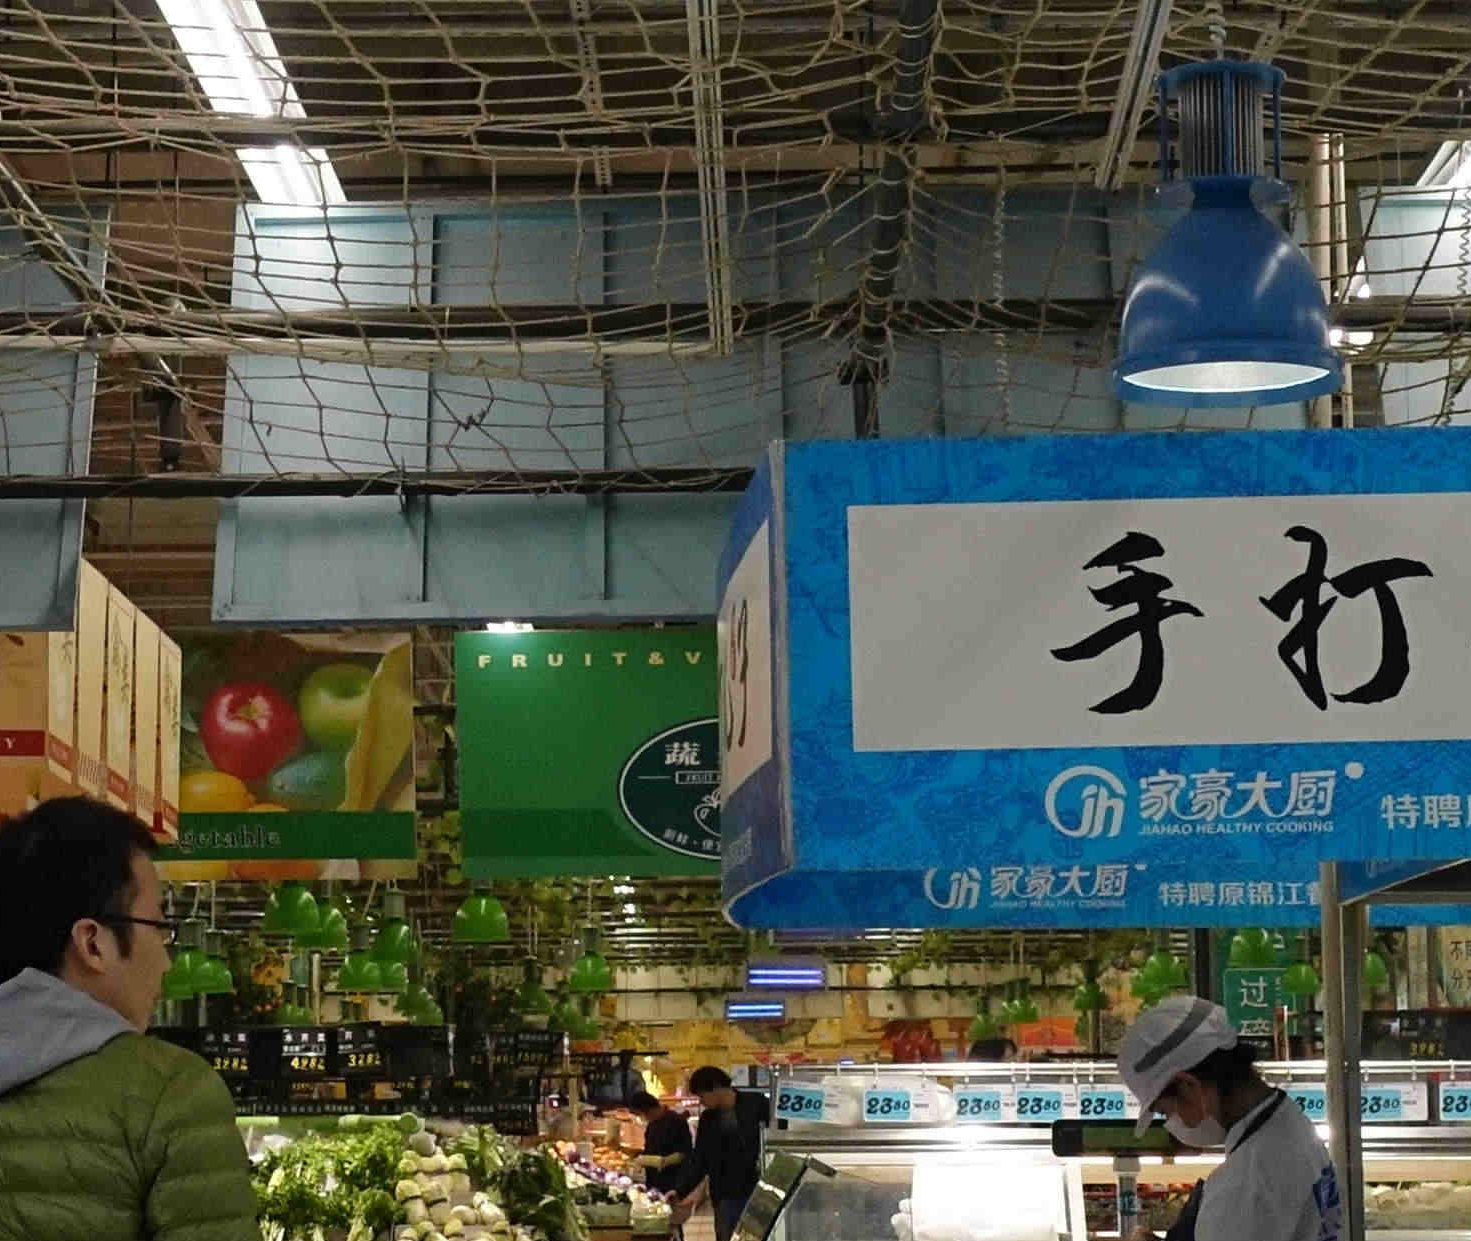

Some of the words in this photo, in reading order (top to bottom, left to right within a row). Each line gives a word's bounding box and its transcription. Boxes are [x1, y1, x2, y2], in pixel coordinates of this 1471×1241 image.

[1139, 769, 1337, 821] 家豪大厨
[1139, 823, 1194, 836] JIAHAO
[1196, 822, 1262, 835] HEALTHY
[1266, 821, 1335, 834] COOKING
[991, 864, 1129, 899] 家豪大厨
